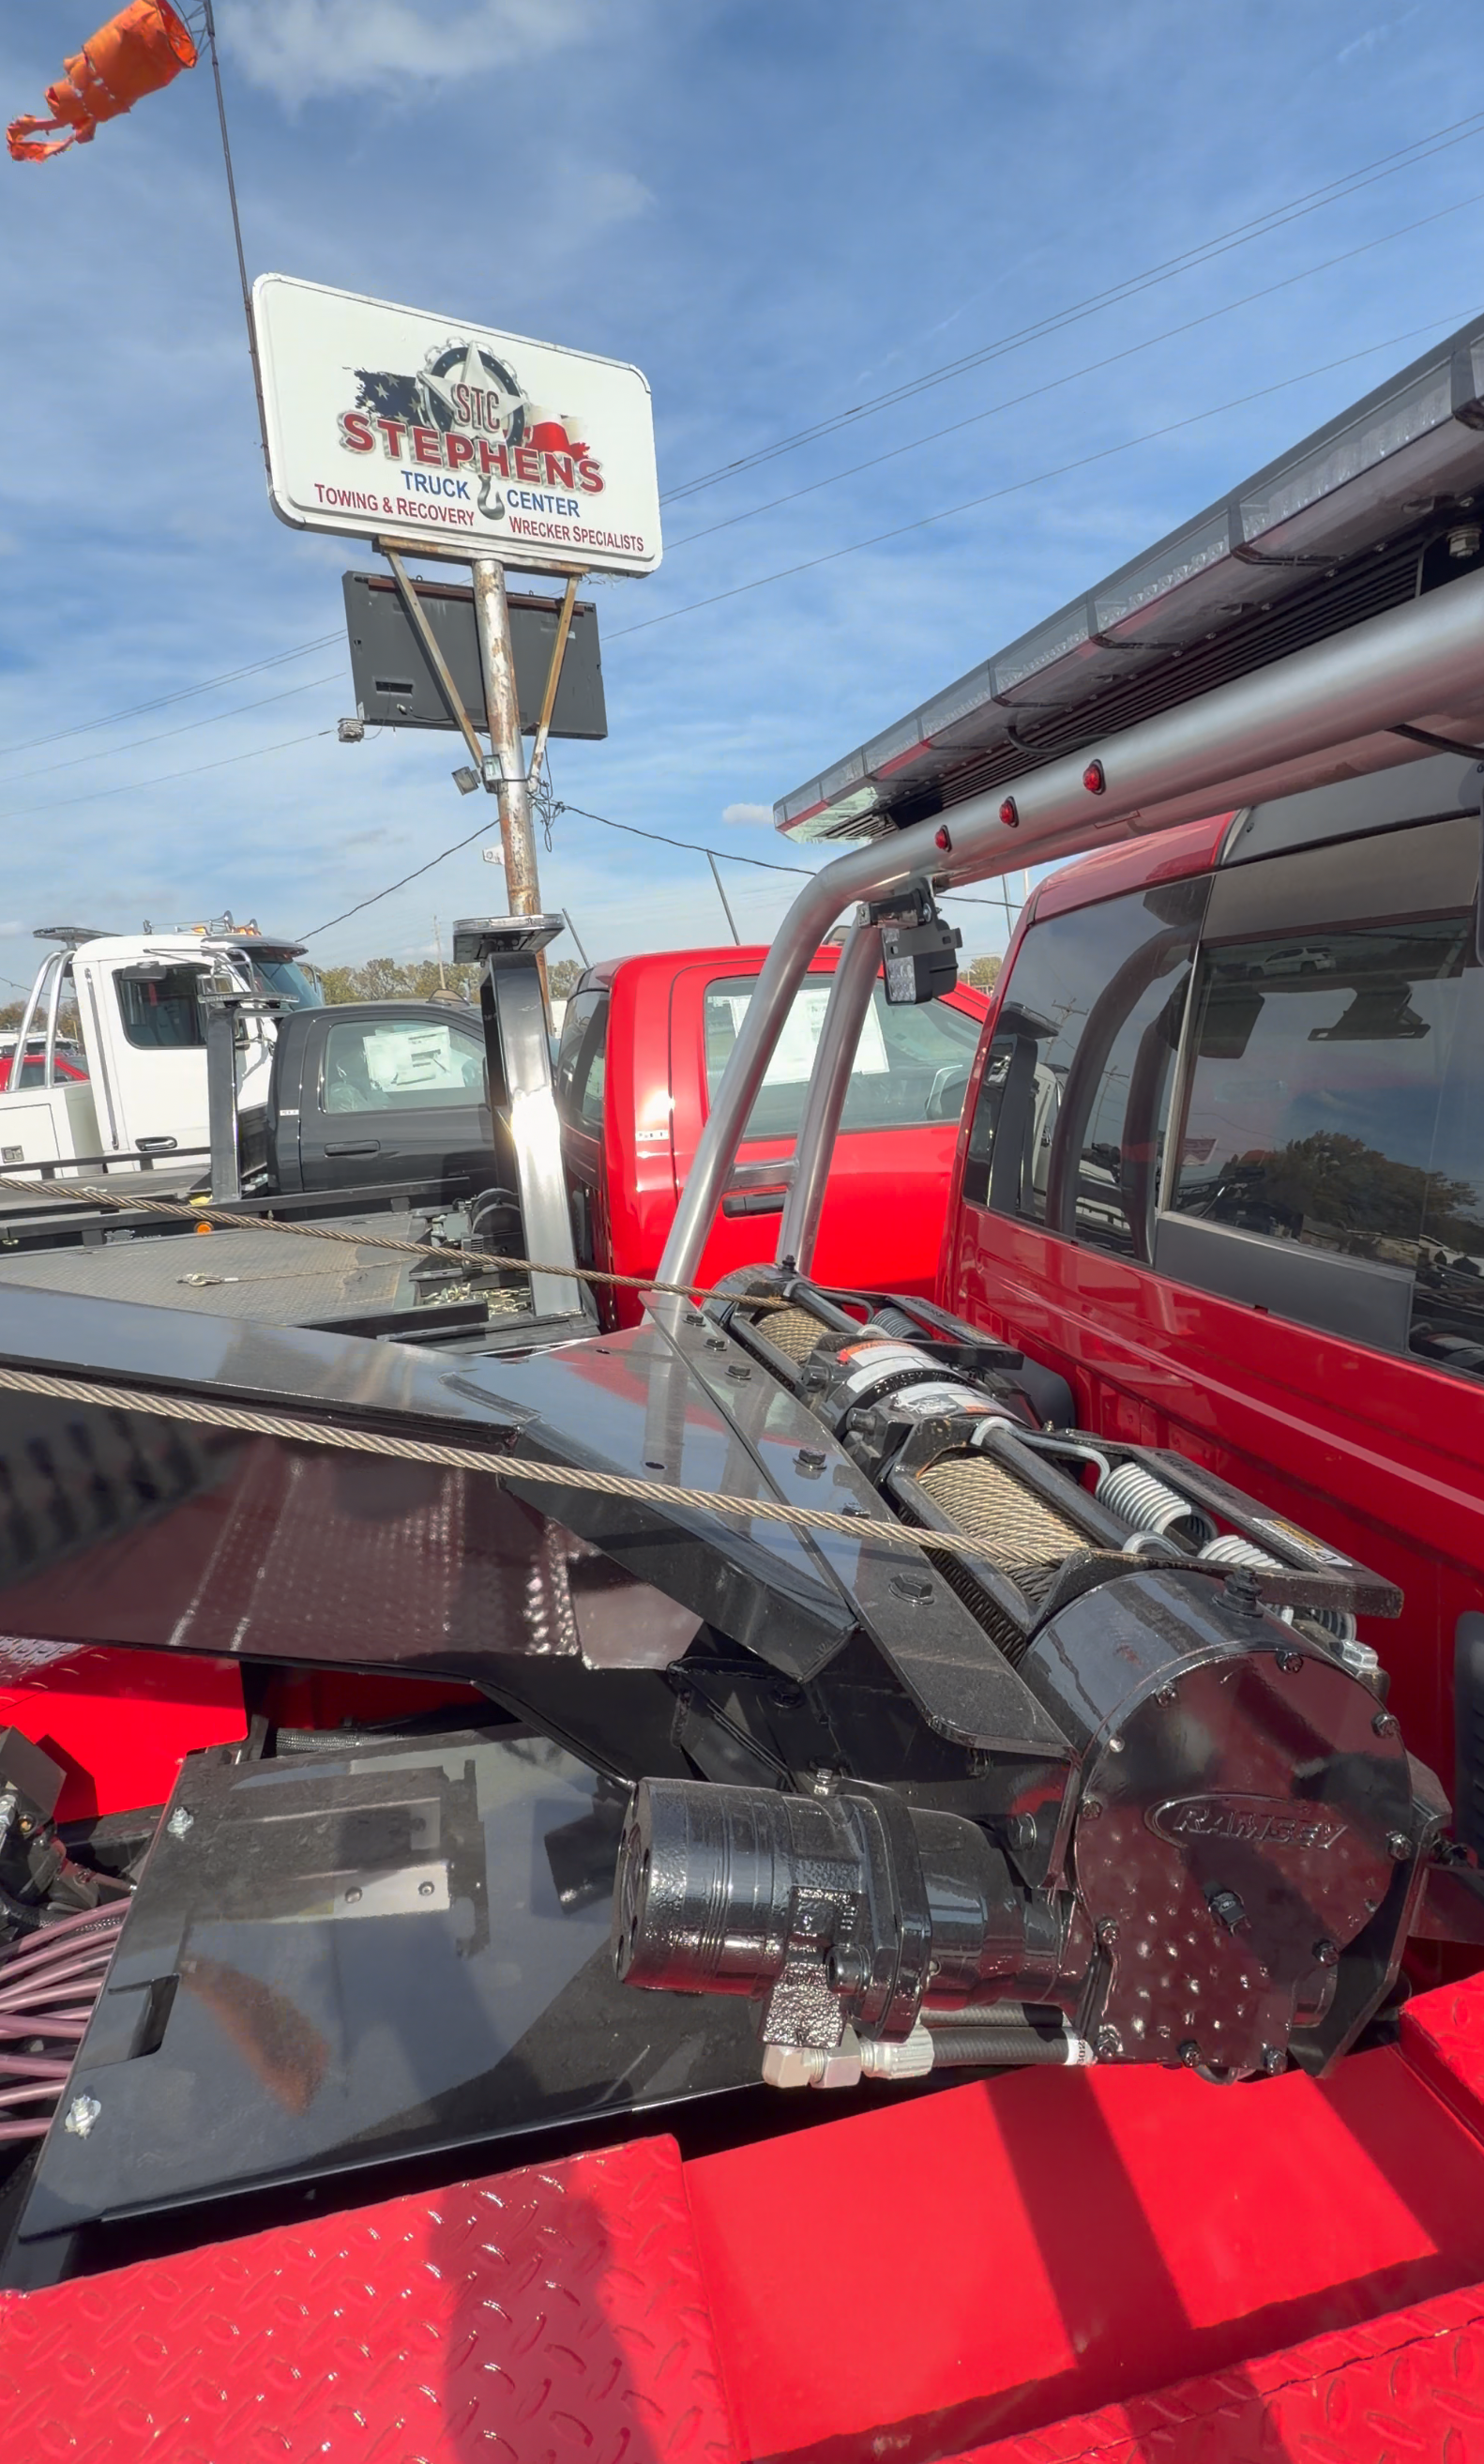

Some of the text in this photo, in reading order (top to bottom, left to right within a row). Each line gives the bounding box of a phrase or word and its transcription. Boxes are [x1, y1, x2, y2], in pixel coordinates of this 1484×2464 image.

[452, 383, 500, 433] STC
[339, 410, 605, 494] STEPHENS
[314, 483, 475, 526] TOWING & RECOVERY
[401, 470, 581, 517] TRUCK CENTER
[508, 516, 644, 552] WRECKER SPECIALISTS
[1174, 1804, 1348, 1849] RAMSEY
